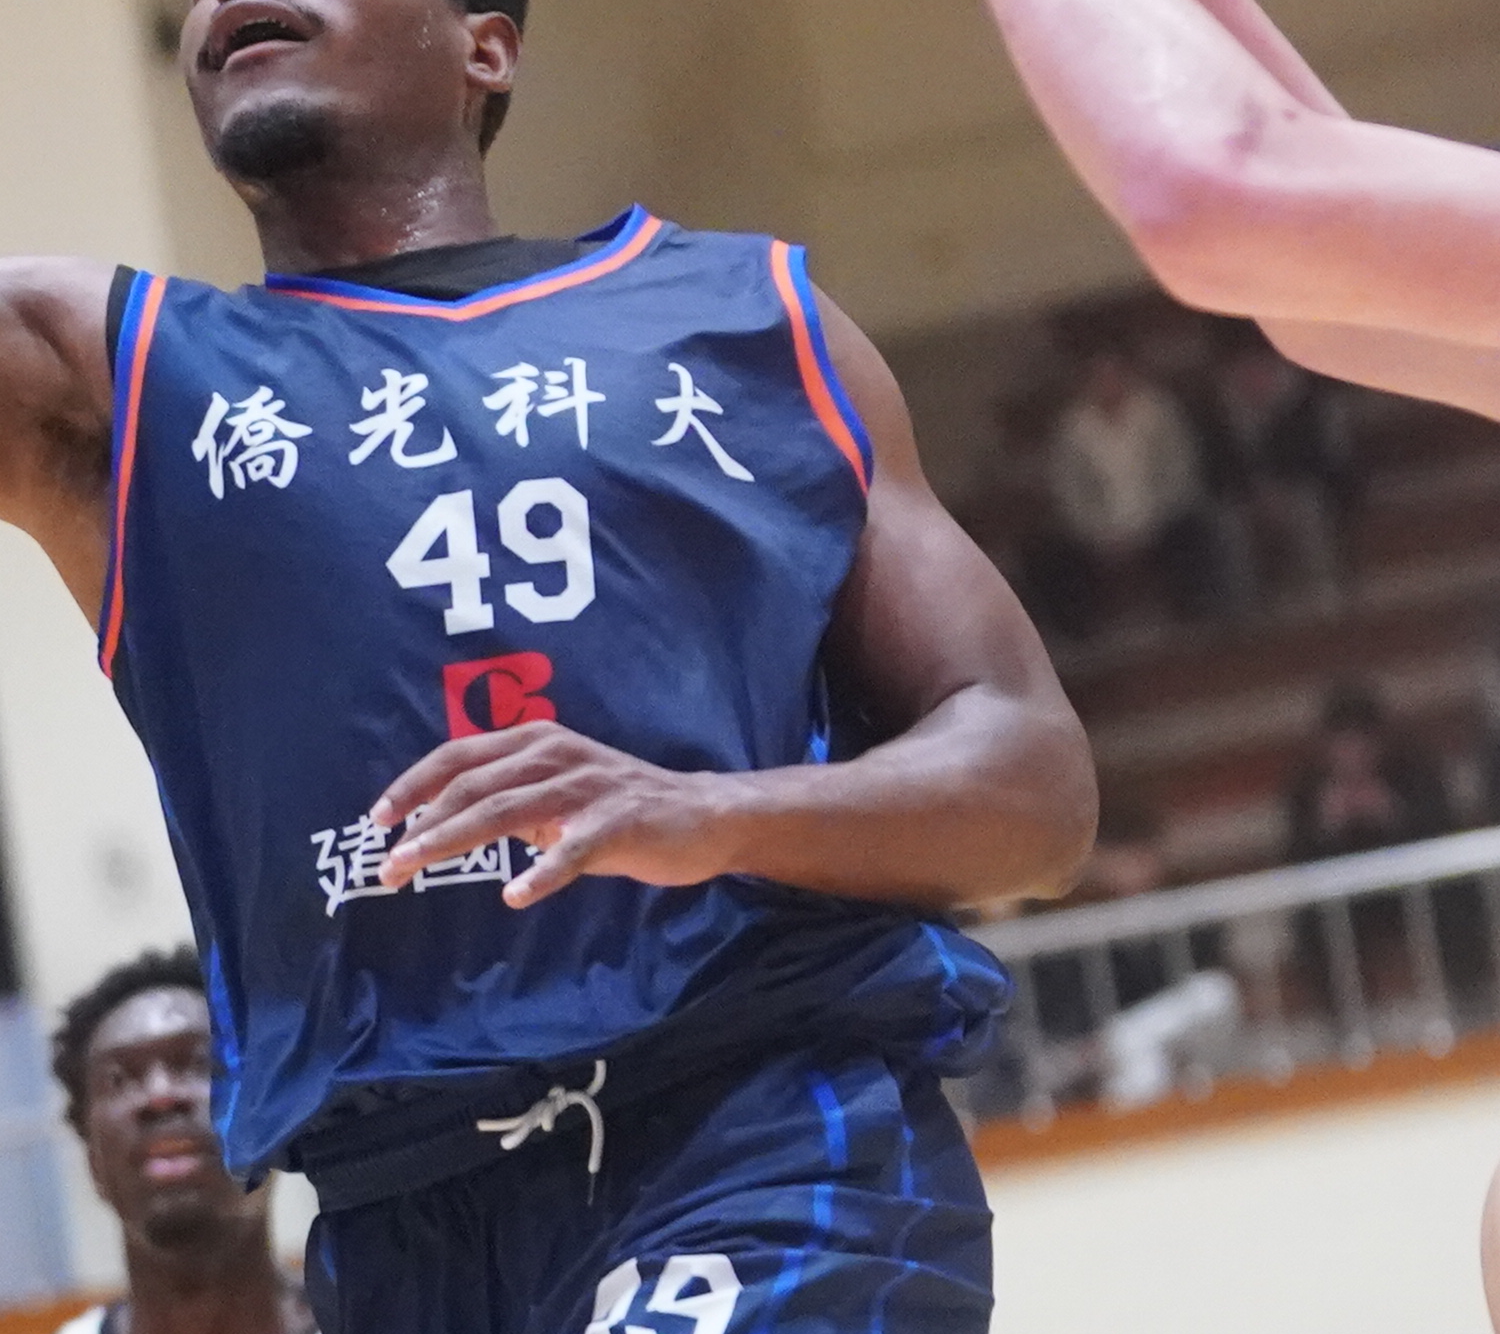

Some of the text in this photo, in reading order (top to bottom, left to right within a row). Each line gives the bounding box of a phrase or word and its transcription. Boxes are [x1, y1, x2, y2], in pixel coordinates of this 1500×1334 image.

[191, 357, 756, 500] 僑光科大
[385, 477, 597, 636] 49
